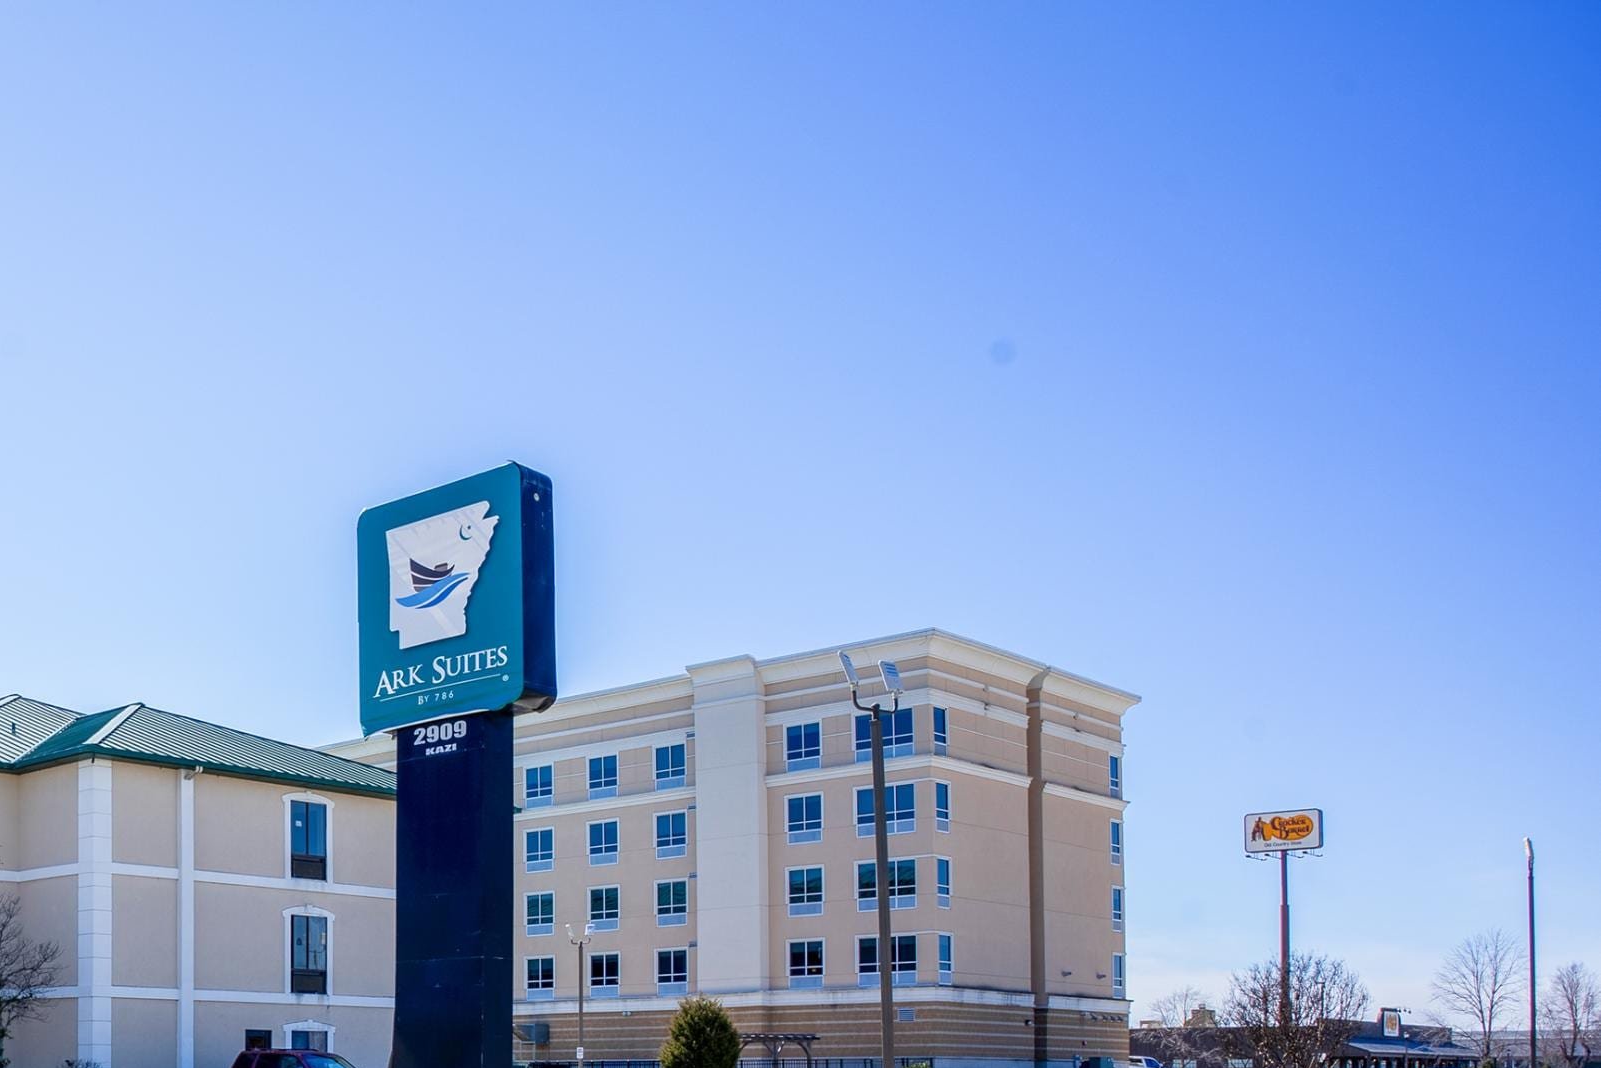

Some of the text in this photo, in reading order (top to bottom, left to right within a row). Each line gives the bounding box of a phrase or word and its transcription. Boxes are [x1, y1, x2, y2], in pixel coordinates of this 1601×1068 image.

[373, 645, 508, 698] ARK SUITES
[417, 690, 454, 705] BY 786
[413, 720, 467, 746] 2909
[425, 743, 457, 756] KAZI
